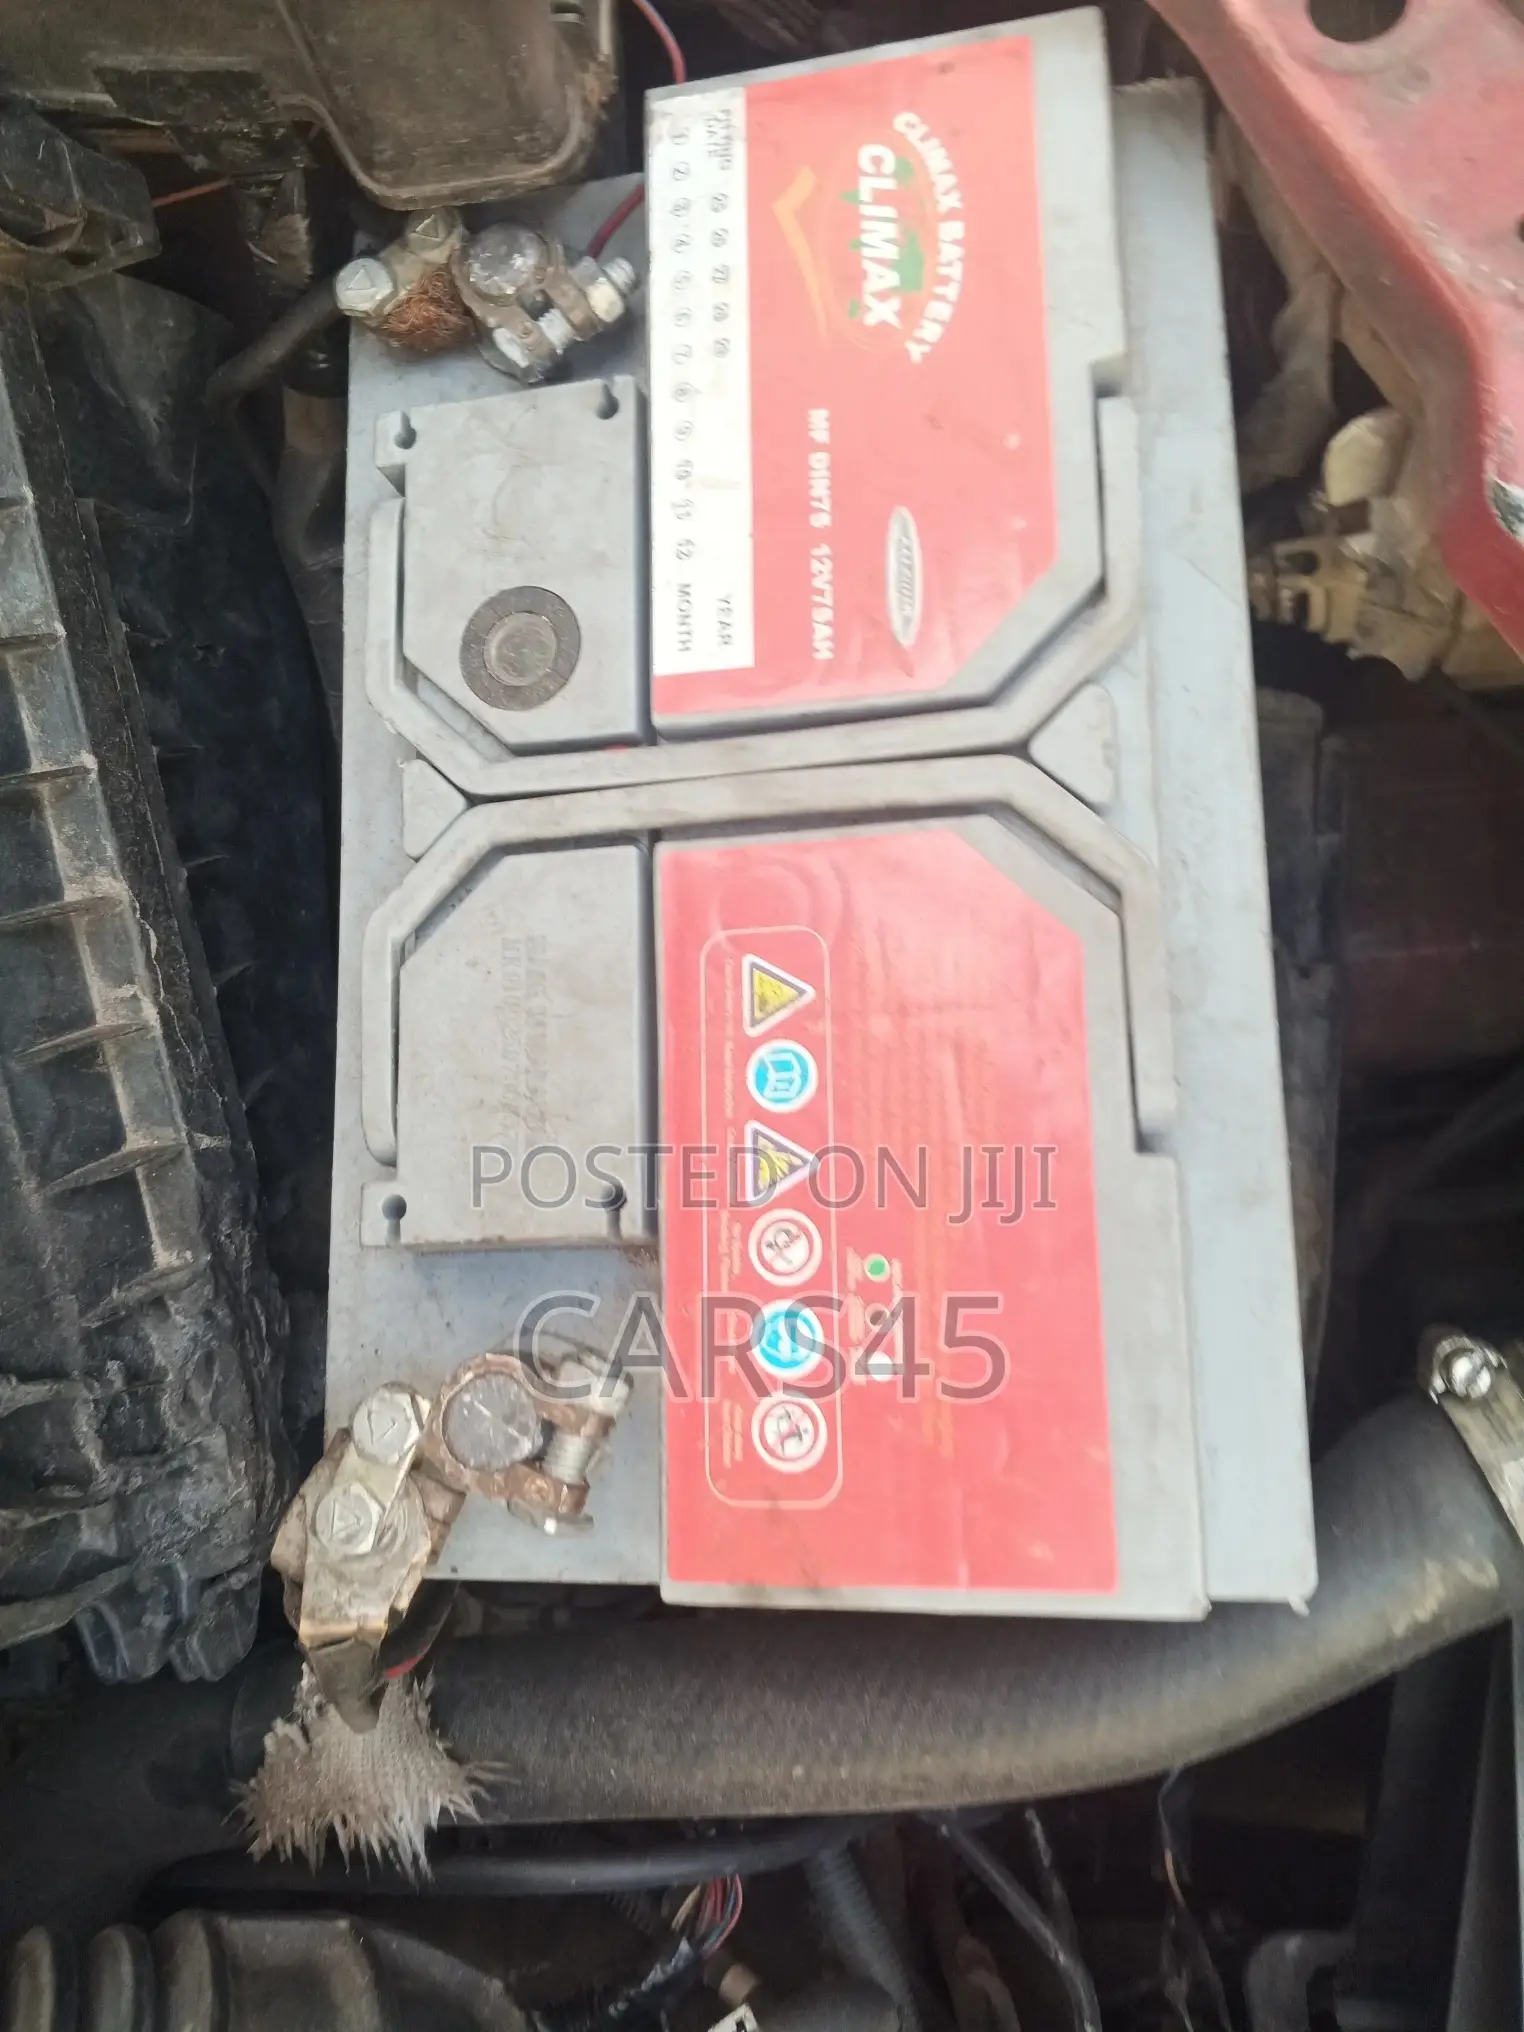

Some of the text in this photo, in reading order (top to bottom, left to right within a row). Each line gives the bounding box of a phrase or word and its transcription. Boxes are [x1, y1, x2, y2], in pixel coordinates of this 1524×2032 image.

[858, 144, 902, 330] CLIMAX
[893, 112, 965, 364] CLIMAX BATTERY
[808, 409, 831, 444] MF
[676, 583, 693, 652] MONTH
[716, 595, 733, 647] YEAR
[810, 543, 834, 660] 12V75AH
